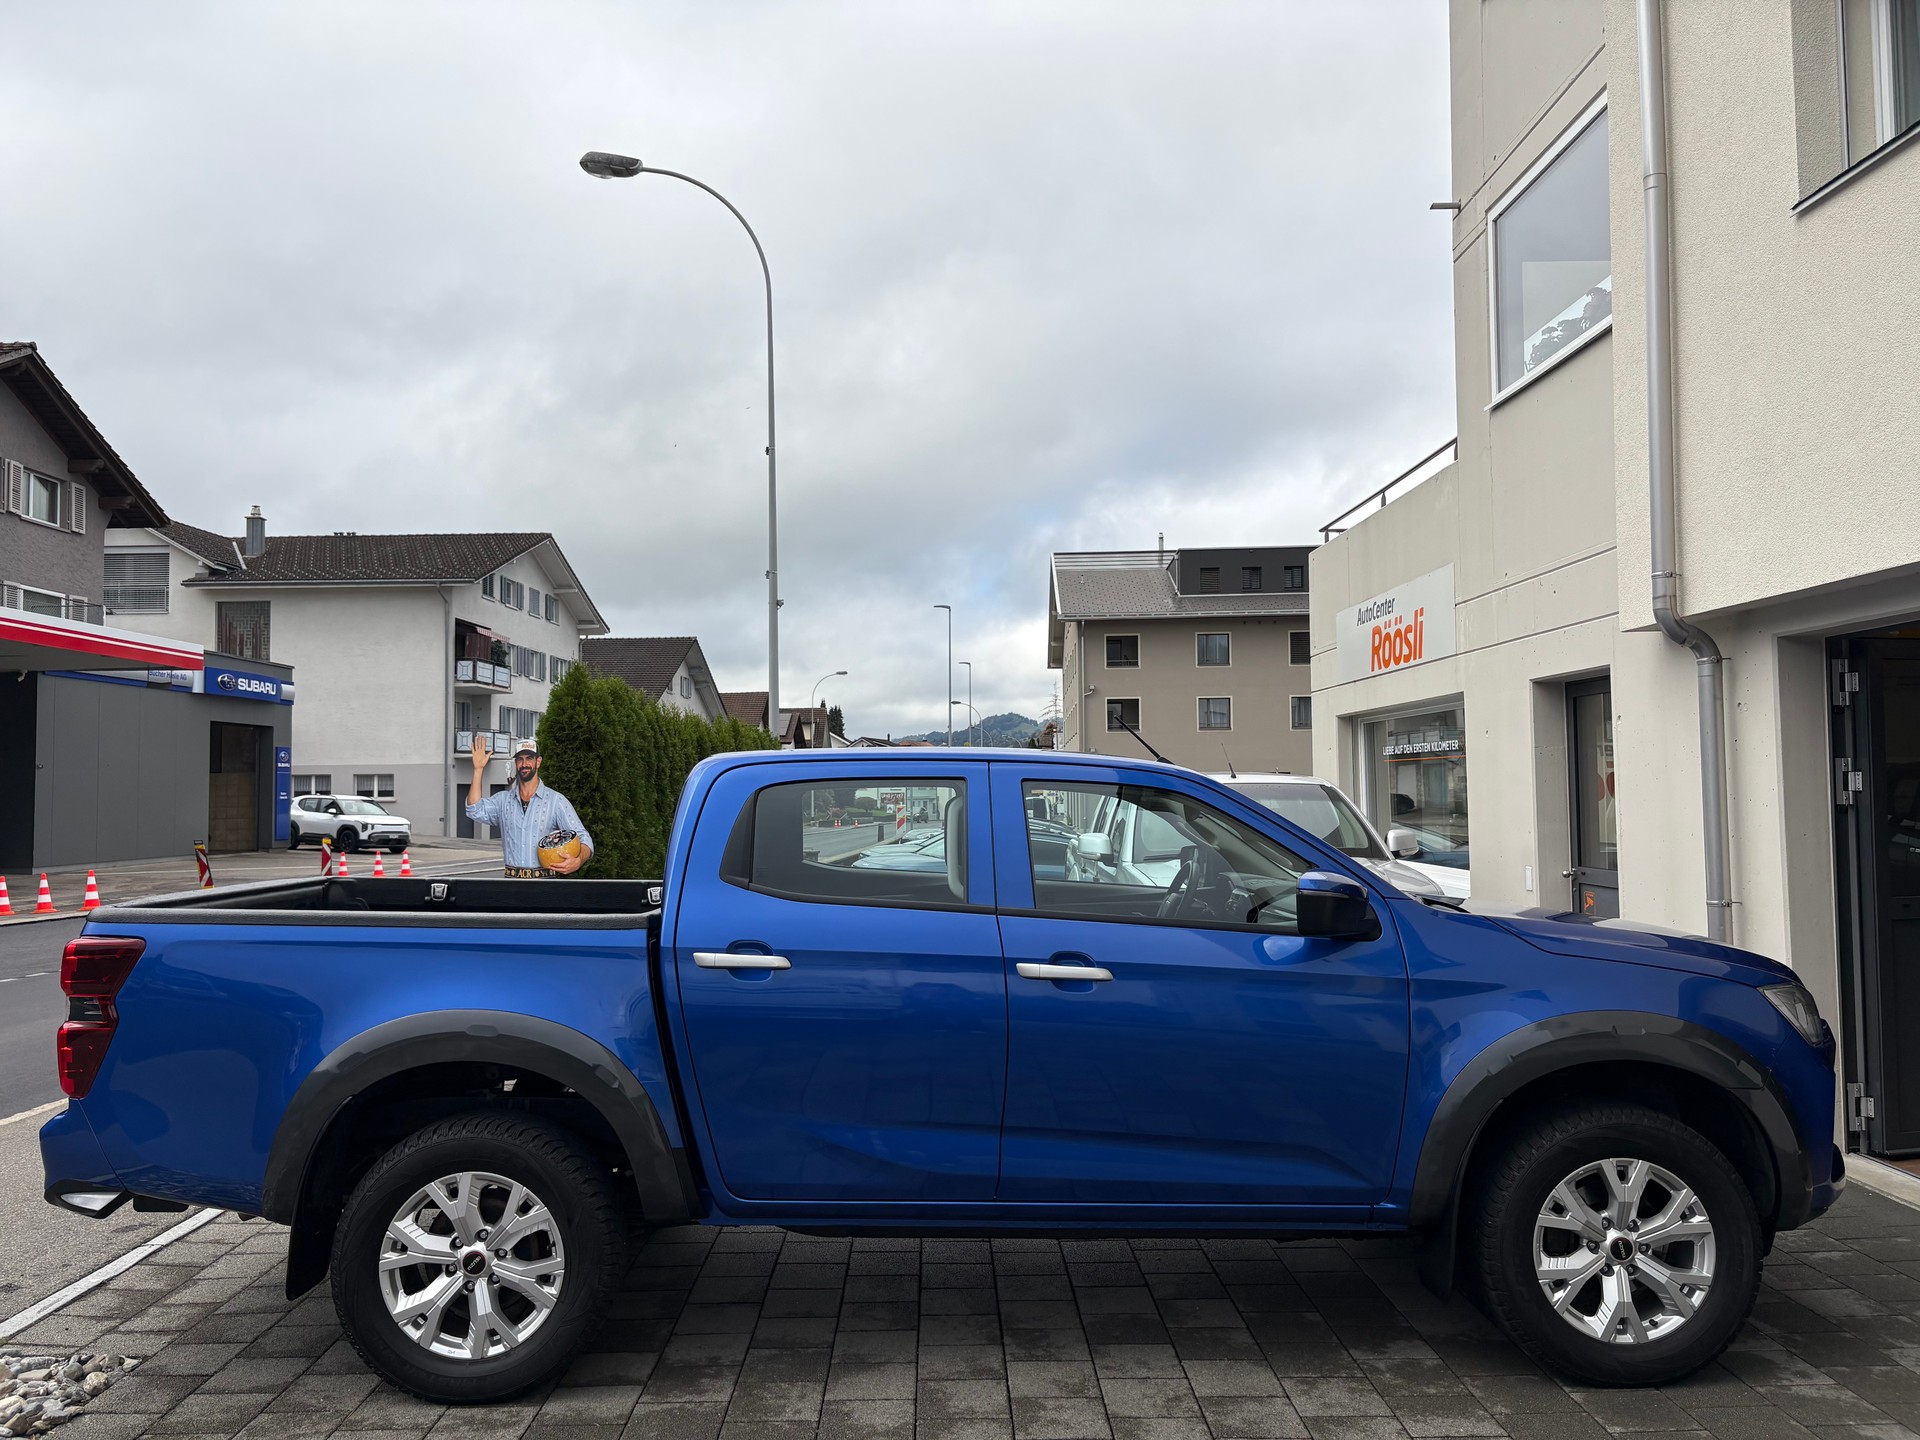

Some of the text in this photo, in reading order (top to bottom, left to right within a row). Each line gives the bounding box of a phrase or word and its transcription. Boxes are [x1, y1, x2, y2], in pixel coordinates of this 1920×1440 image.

[1357, 598, 1395, 626] AutoCenter
[1371, 607, 1424, 672] Röösli
[180, 673, 187, 681] AG
[237, 678, 276, 695] SUBARU
[1383, 740, 1458, 755] LIEBE AUF DEN ERSTEN KILOMETER
